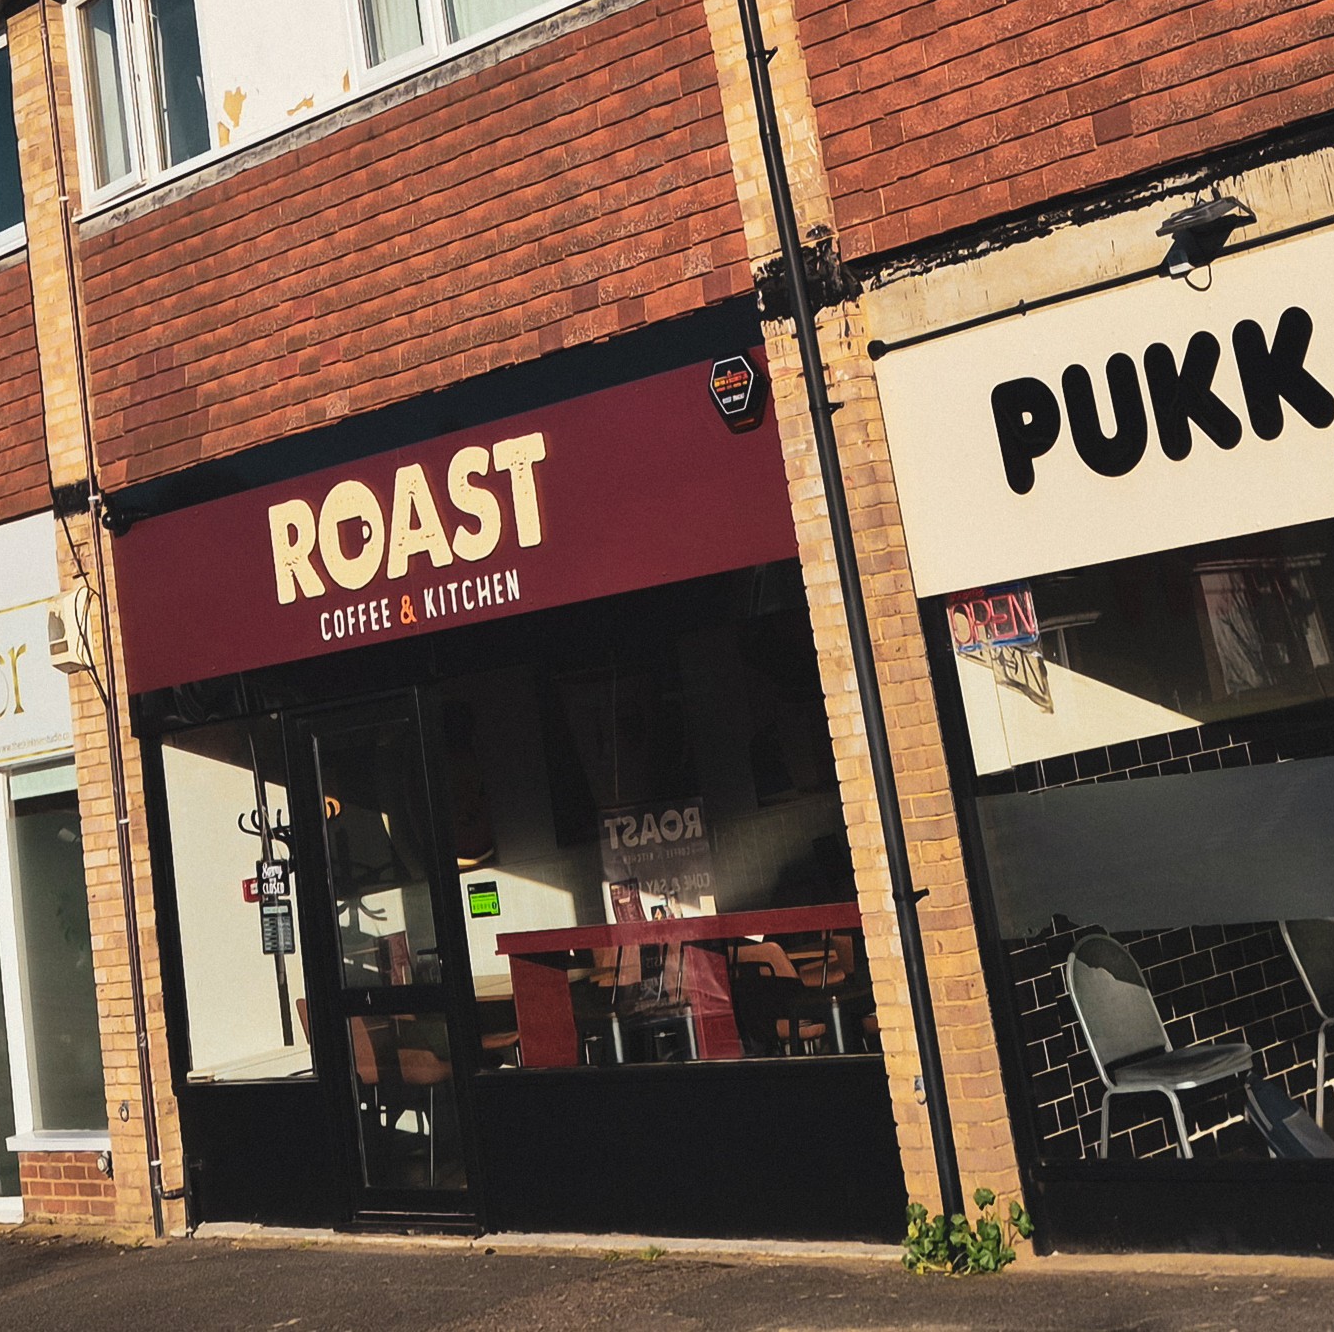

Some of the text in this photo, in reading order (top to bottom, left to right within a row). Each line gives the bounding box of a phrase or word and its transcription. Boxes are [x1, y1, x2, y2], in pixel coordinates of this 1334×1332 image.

[268, 432, 547, 605] ROAST
[320, 568, 521, 641] COFFEE & KITCHEN
[951, 591, 1036, 645] OPEN
